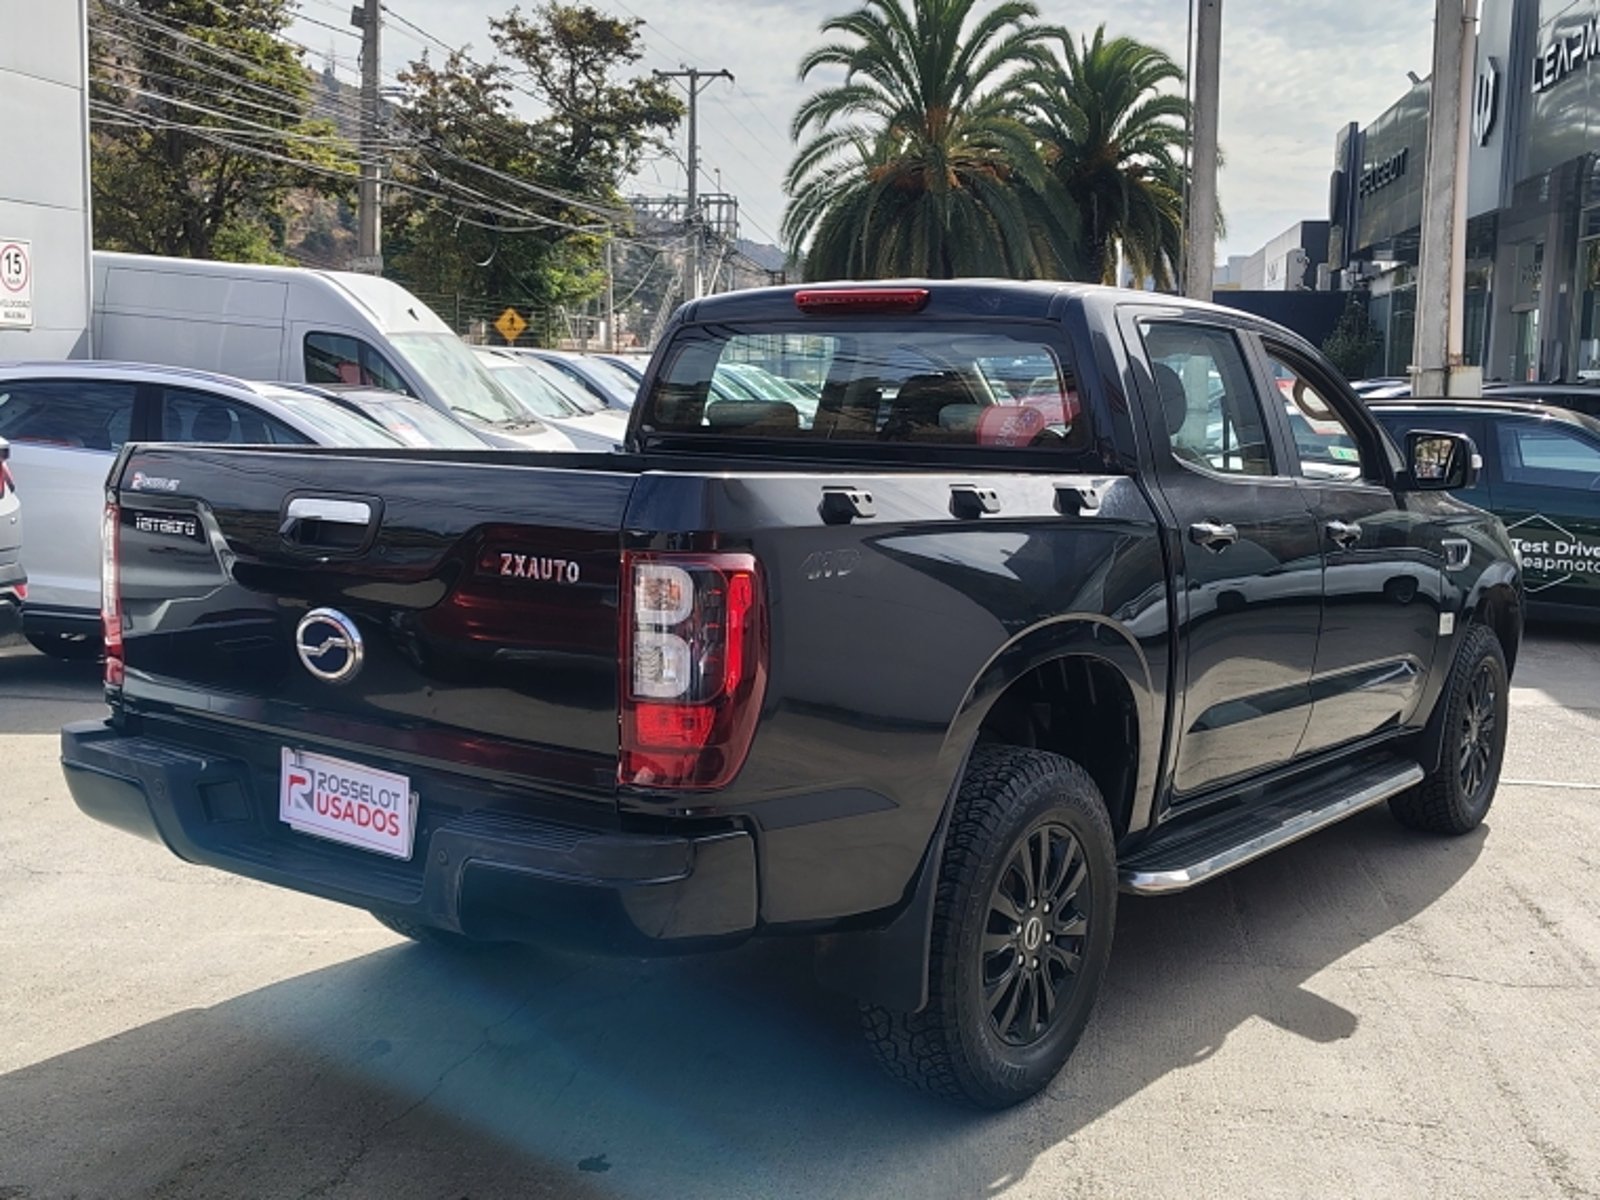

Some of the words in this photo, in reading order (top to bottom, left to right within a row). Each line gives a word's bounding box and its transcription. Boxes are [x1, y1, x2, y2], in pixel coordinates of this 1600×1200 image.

[5, 252, 22, 275] 15
[1510, 538, 1549, 554] Test
[500, 552, 580, 583] ZXAUTO
[1521, 557, 1600, 573] eapmoto
[317, 771, 401, 811] ROSSELOT
[316, 791, 400, 837] USADOS
